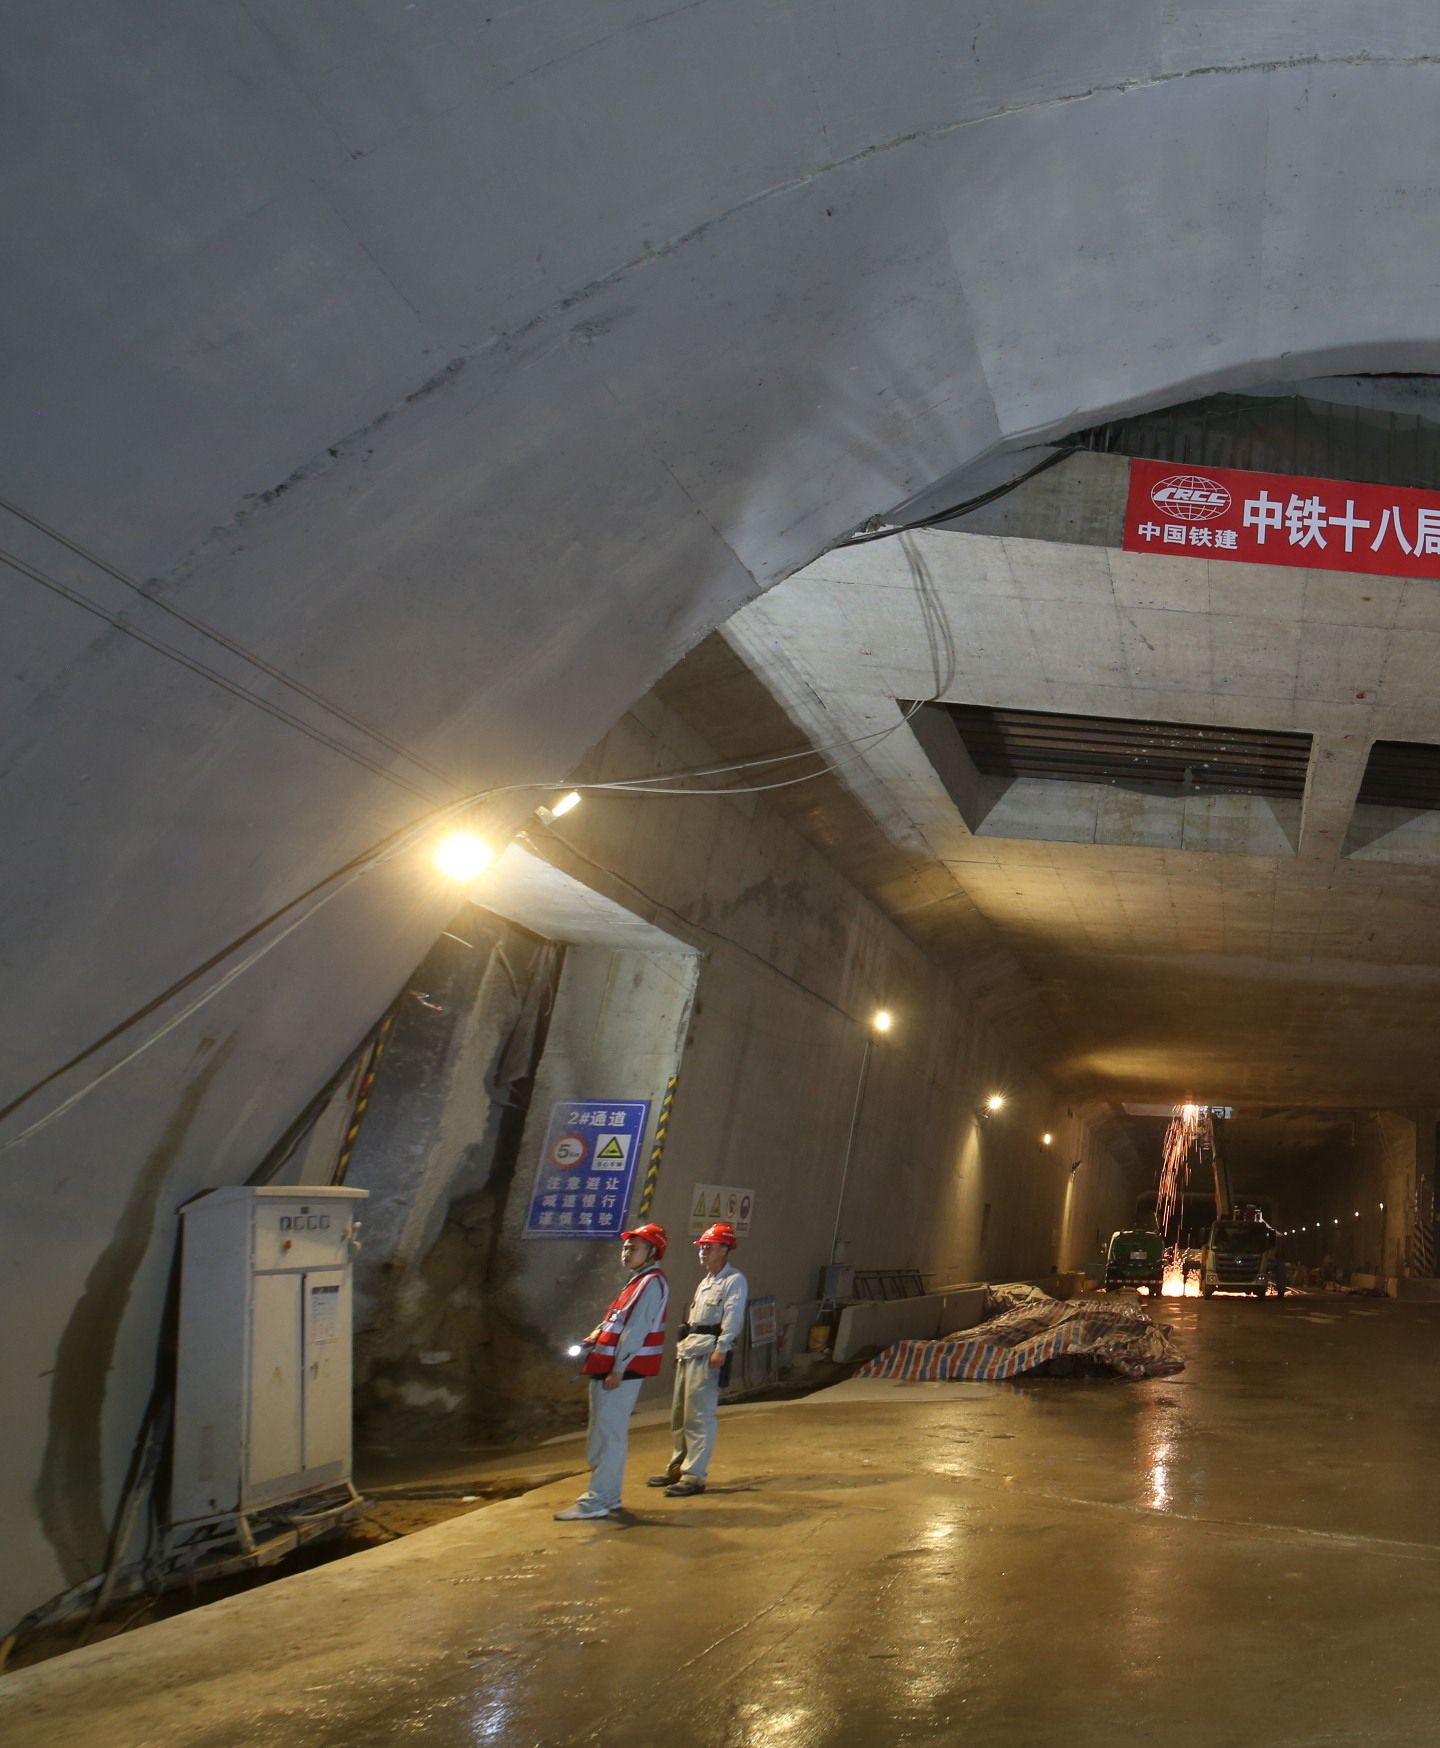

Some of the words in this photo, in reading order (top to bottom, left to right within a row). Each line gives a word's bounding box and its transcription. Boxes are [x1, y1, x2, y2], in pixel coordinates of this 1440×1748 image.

[1153, 487, 1229, 506] CRCC
[1138, 522, 1239, 550] 中国铁建
[568, 1111, 627, 1127] 2#通道
[546, 1176, 620, 1190] 注意避让
[542, 1194, 616, 1208] 减速慢行
[539, 1212, 613, 1226] 谨慎驾驶
